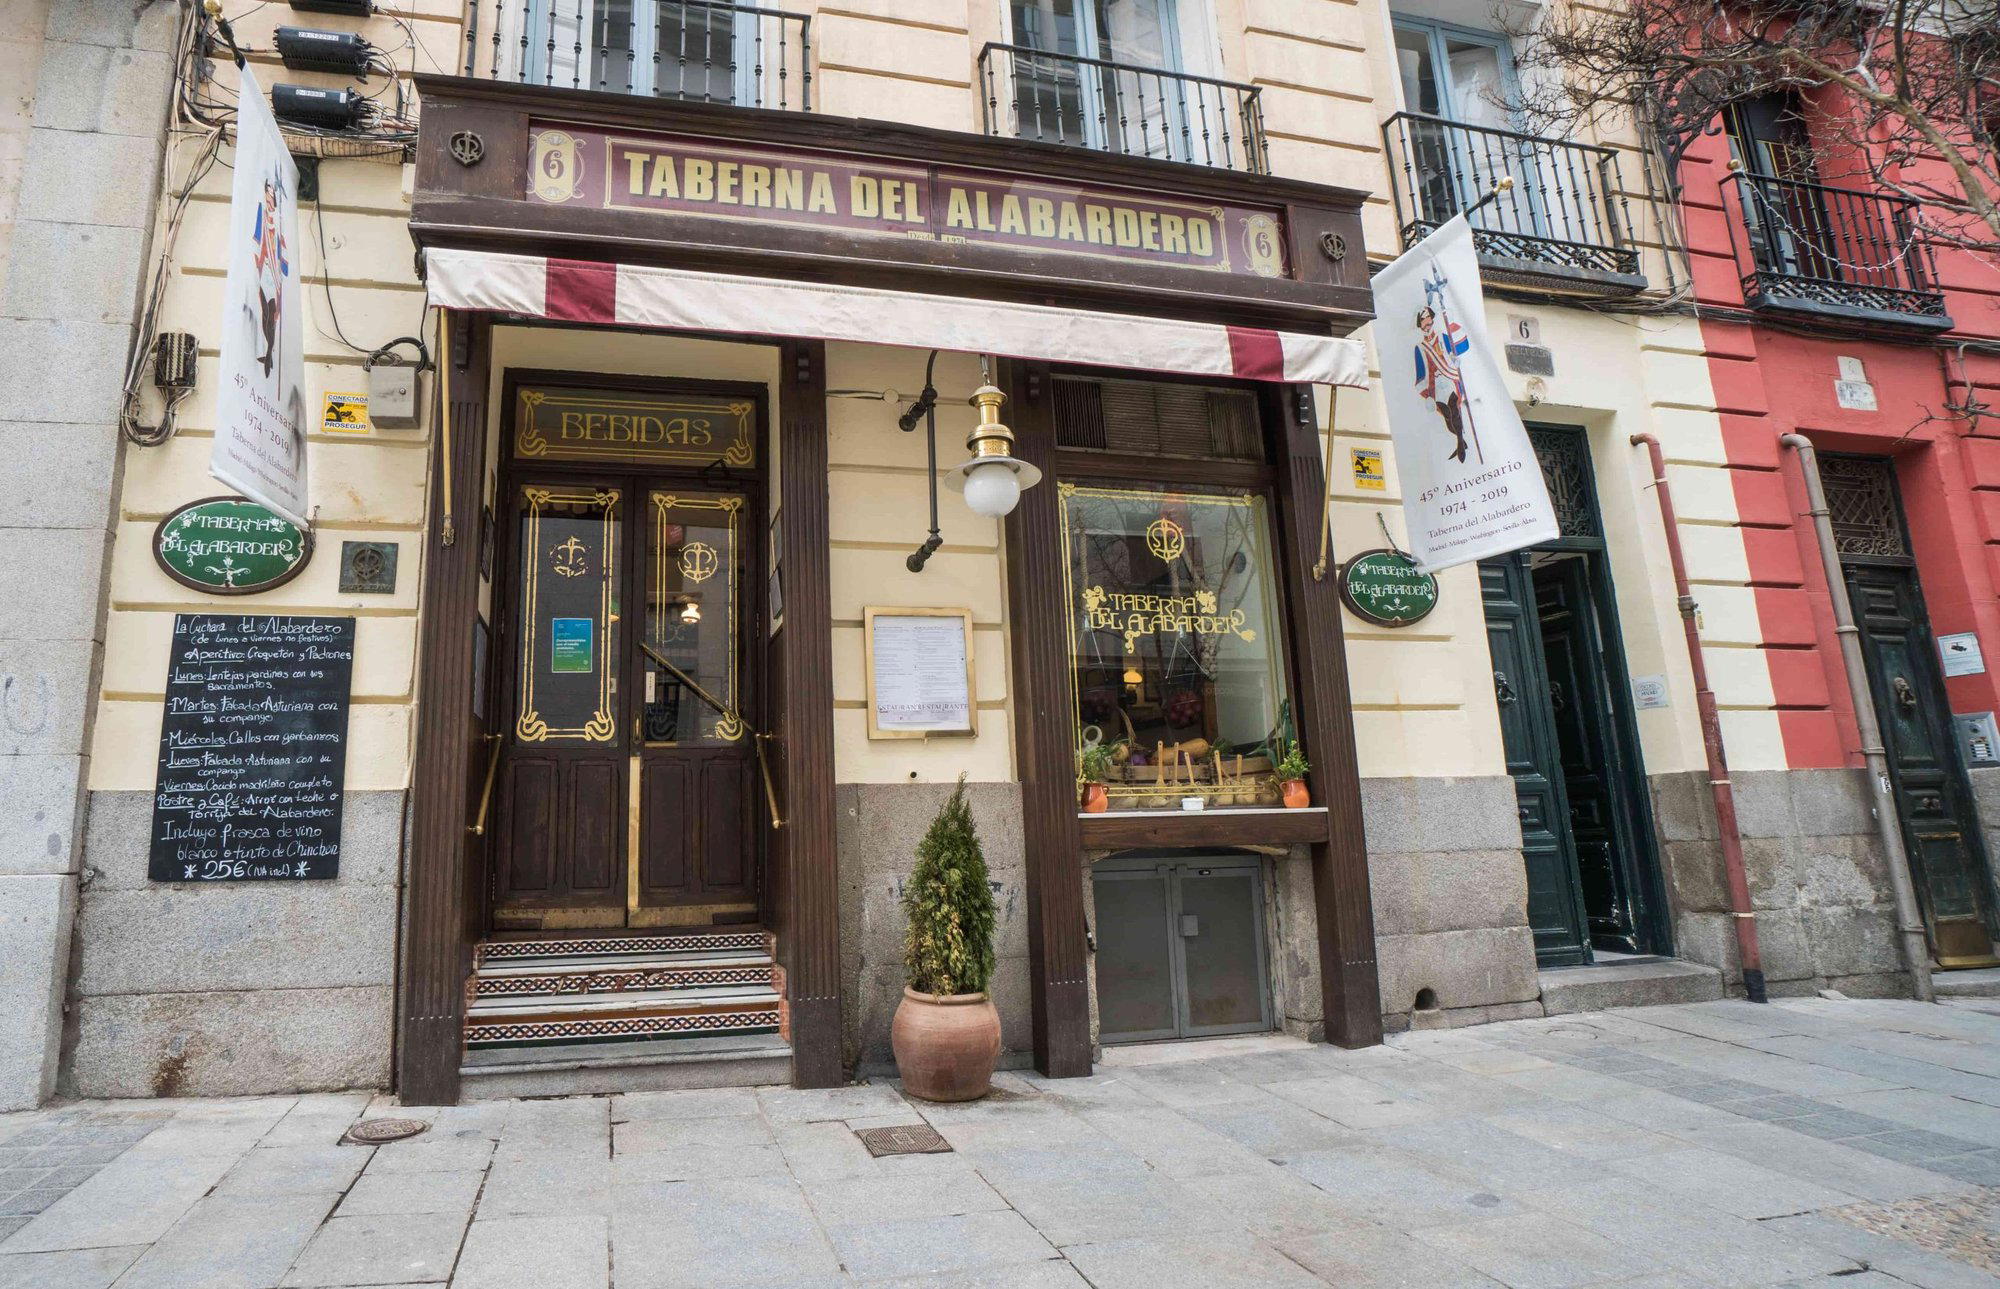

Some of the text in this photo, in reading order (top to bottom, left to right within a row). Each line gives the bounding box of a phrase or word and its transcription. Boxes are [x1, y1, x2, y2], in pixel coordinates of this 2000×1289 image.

[542, 149, 564, 180] 6
[623, 151, 1214, 257] TABERNA DEL ALABARDERO
[1255, 229, 1273, 260] 6
[1519, 320, 1530, 339] 6
[327, 394, 369, 403] CONECTADA
[249, 387, 297, 435] Aniversari
[243, 409, 262, 434] 1974
[270, 430, 290, 454] 2019
[324, 422, 367, 430] PROSEGUR
[561, 412, 713, 446] BEBIDAS
[1444, 460, 1522, 496] Aniversario
[1440, 501, 1467, 516] 1974
[1481, 486, 1509, 503] 2019
[197, 515, 272, 532] TABERNA
[1428, 502, 1530, 539] Taberna del Alabardero
[160, 538, 188, 553] DEL
[1109, 593, 1197, 616] TABERNA
[175, 614, 342, 635] La Cuchara del Alabardero
[1090, 608, 1124, 629] DEL
[299, 652, 305, 661] y
[306, 646, 352, 660] Padrones
[246, 670, 289, 682] pardinas
[293, 670, 307, 679] con
[221, 695, 260, 712] Fabada
[260, 696, 314, 712] Asturiana
[318, 702, 338, 711] con
[203, 714, 273, 725] su compango
[229, 731, 262, 745] Callos
[264, 734, 280, 742] con
[202, 751, 242, 766] Fabada
[245, 751, 290, 766] Asturiana
[198, 768, 246, 779] compango
[158, 794, 194, 809] Postre
[244, 794, 275, 805] Arroz
[239, 807, 257, 817] del
[161, 820, 322, 847] Incluye frasca de vino
[177, 843, 218, 860] blanco
[233, 844, 270, 859] tinto
[273, 846, 284, 858] de
[201, 859, 247, 880] 25€
